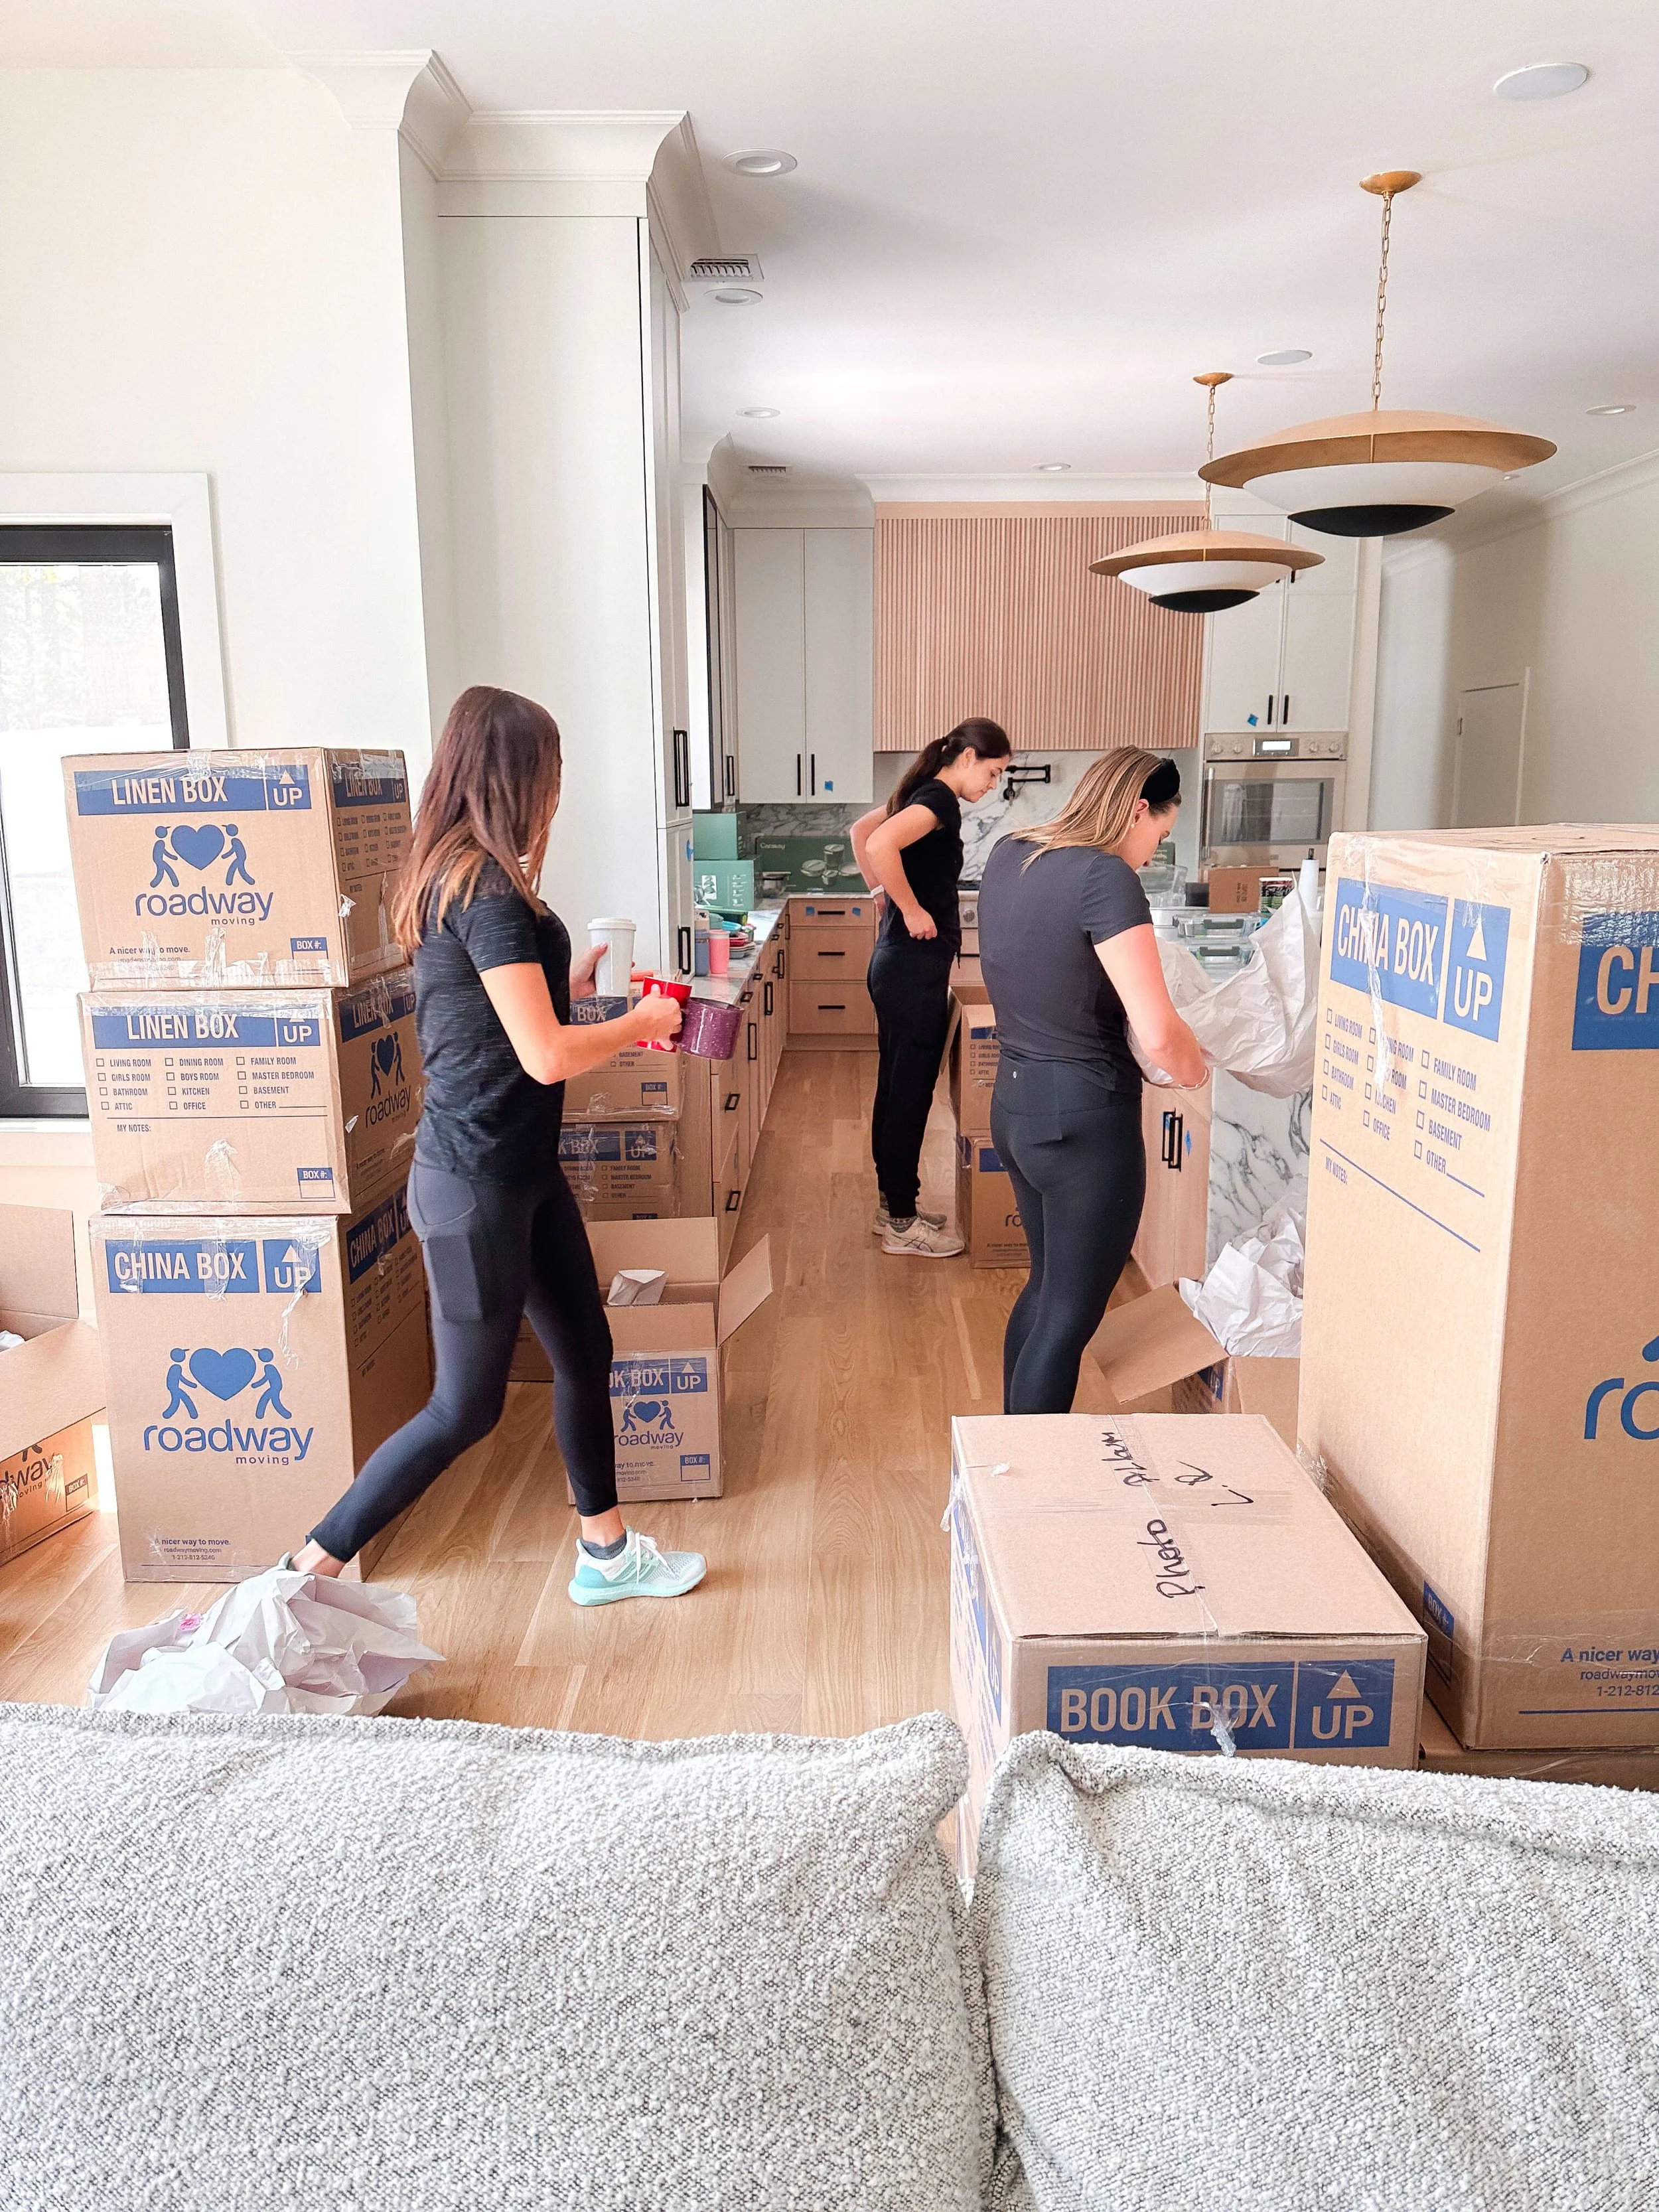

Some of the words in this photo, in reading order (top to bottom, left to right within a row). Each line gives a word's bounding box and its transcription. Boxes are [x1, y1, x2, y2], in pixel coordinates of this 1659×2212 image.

[111, 778, 177, 806] LINEN
[182, 776, 228, 803] BOX
[273, 787, 303, 806] UP
[344, 772, 367, 797] LINEN
[368, 776, 382, 796] BOX
[394, 782, 403, 799] UP
[135, 886, 273, 921] roadway
[211, 916, 255, 926] moving
[296, 940, 313, 951] BOX
[1394, 917, 1439, 986] BOX
[1453, 966, 1493, 1021] UP
[577, 1005, 607, 1021] BOX
[127, 1014, 188, 1039] LINEN
[194, 1013, 239, 1039] BOX
[283, 1025, 312, 1043] UP
[1334, 1013, 1348, 1033] LIVING
[1349, 1020, 1362, 1039] ROOM
[109, 1059, 131, 1067] LIVING
[179, 1058, 202, 1067] DINING
[1333, 1040, 1345, 1059] GIRLS
[1345, 1046, 1359, 1065] ROOM
[1398, 1041, 1413, 1063] ROOM
[111, 1073, 130, 1082] GIRLS
[1331, 1065, 1354, 1090] BATHROOM
[1391, 1069, 1407, 1090] ROOM
[1433, 1057, 1456, 1082] FAMILY
[1457, 1067, 1477, 1091] ROOM
[253, 1086, 289, 1094] BASEMENT
[1329, 1092, 1341, 1110] ATTIC
[365, 1084, 411, 1128] roadway
[1431, 1088, 1456, 1114] MASTER
[1457, 1101, 1491, 1132] BEDROOM
[1372, 1118, 1390, 1141] OFFICE
[1428, 1120, 1463, 1151] BASEMENT
[303, 1170, 319, 1179] BOX
[1325, 1156, 1331, 1172] MY
[1332, 1162, 1348, 1185] NOTES:
[1426, 1149, 1447, 1175] OTHER
[350, 1224, 377, 1268] CHINA
[378, 1209, 395, 1243] BOX
[114, 1252, 189, 1281] CHINA
[198, 1252, 247, 1280] BOX
[274, 1266, 311, 1288] UP
[630, 1368, 664, 1387] BOX
[677, 1375, 701, 1390] UP
[1584, 1377, 1659, 1440] ro
[143, 1419, 314, 1460] roadway
[236, 1455, 290, 1465] moving
[19, 1481, 42, 1498] oving
[68, 1482, 79, 1493] BOX
[1137, 1519, 1205, 1598] Photo
[1428, 1593, 1442, 1621] BOX
[1560, 1648, 1574, 1662] A
[1579, 1647, 1623, 1662] nicer
[1628, 1649, 1659, 1664] way
[1061, 1686, 1178, 1733] BOOK
[1192, 1684, 1278, 1730] BOX
[1311, 1705, 1374, 1739] UP
